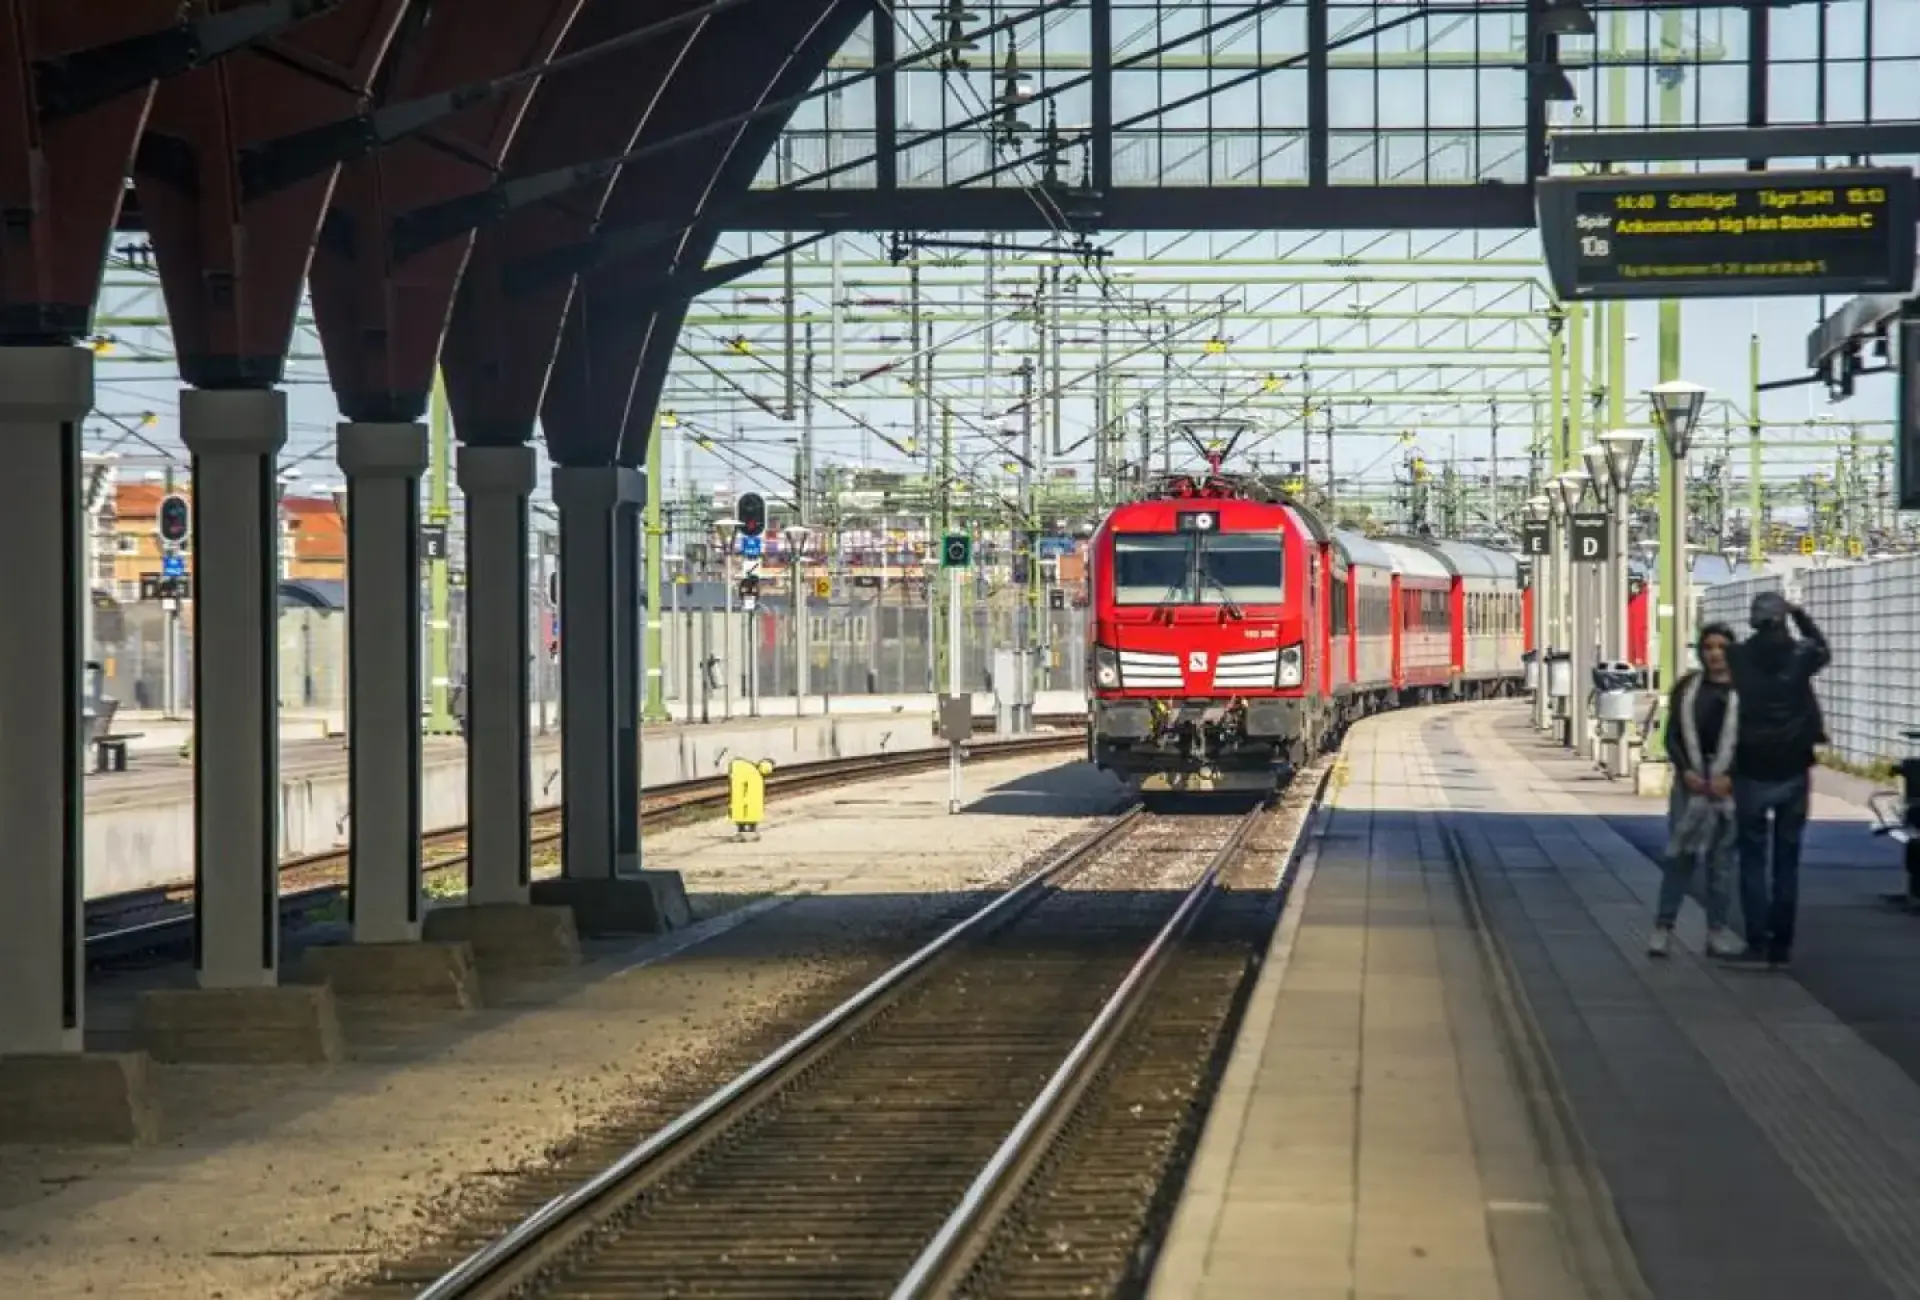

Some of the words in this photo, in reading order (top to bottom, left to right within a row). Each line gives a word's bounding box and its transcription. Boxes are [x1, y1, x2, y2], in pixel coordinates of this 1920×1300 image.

[1780, 212, 1858, 230] Stockholm
[1859, 212, 1873, 228] C
[1531, 536, 1542, 551] E
[1583, 536, 1598, 556] D
